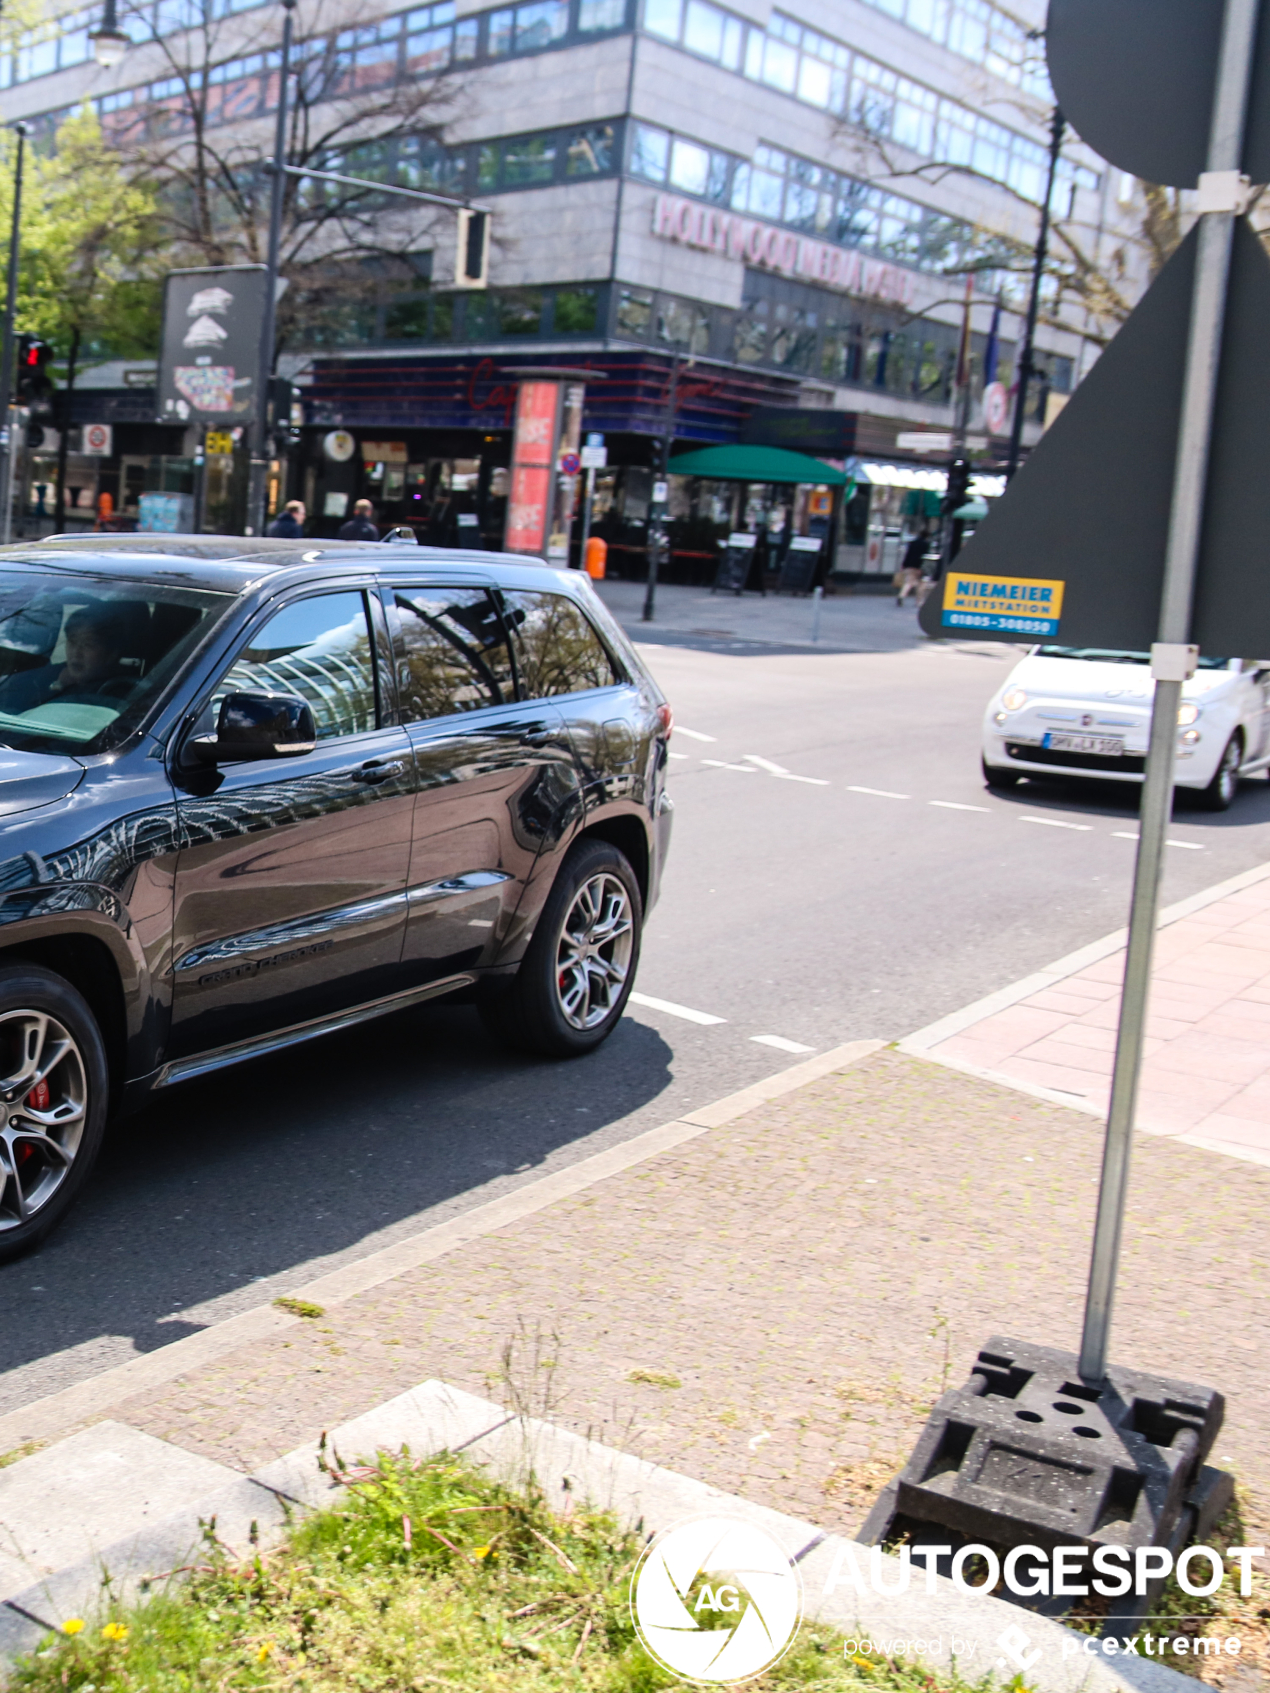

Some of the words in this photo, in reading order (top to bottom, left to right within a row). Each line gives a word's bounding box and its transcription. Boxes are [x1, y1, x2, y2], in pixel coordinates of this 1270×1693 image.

[653, 194, 798, 269] HOLLYWOOD
[956, 580, 1053, 602] NIEMEIER
[955, 598, 1051, 614] MIETSTATION
[949, 613, 1051, 632] 01805-308050
[198, 962, 256, 985] GRAND
[256, 939, 335, 969] CHEROKEE
